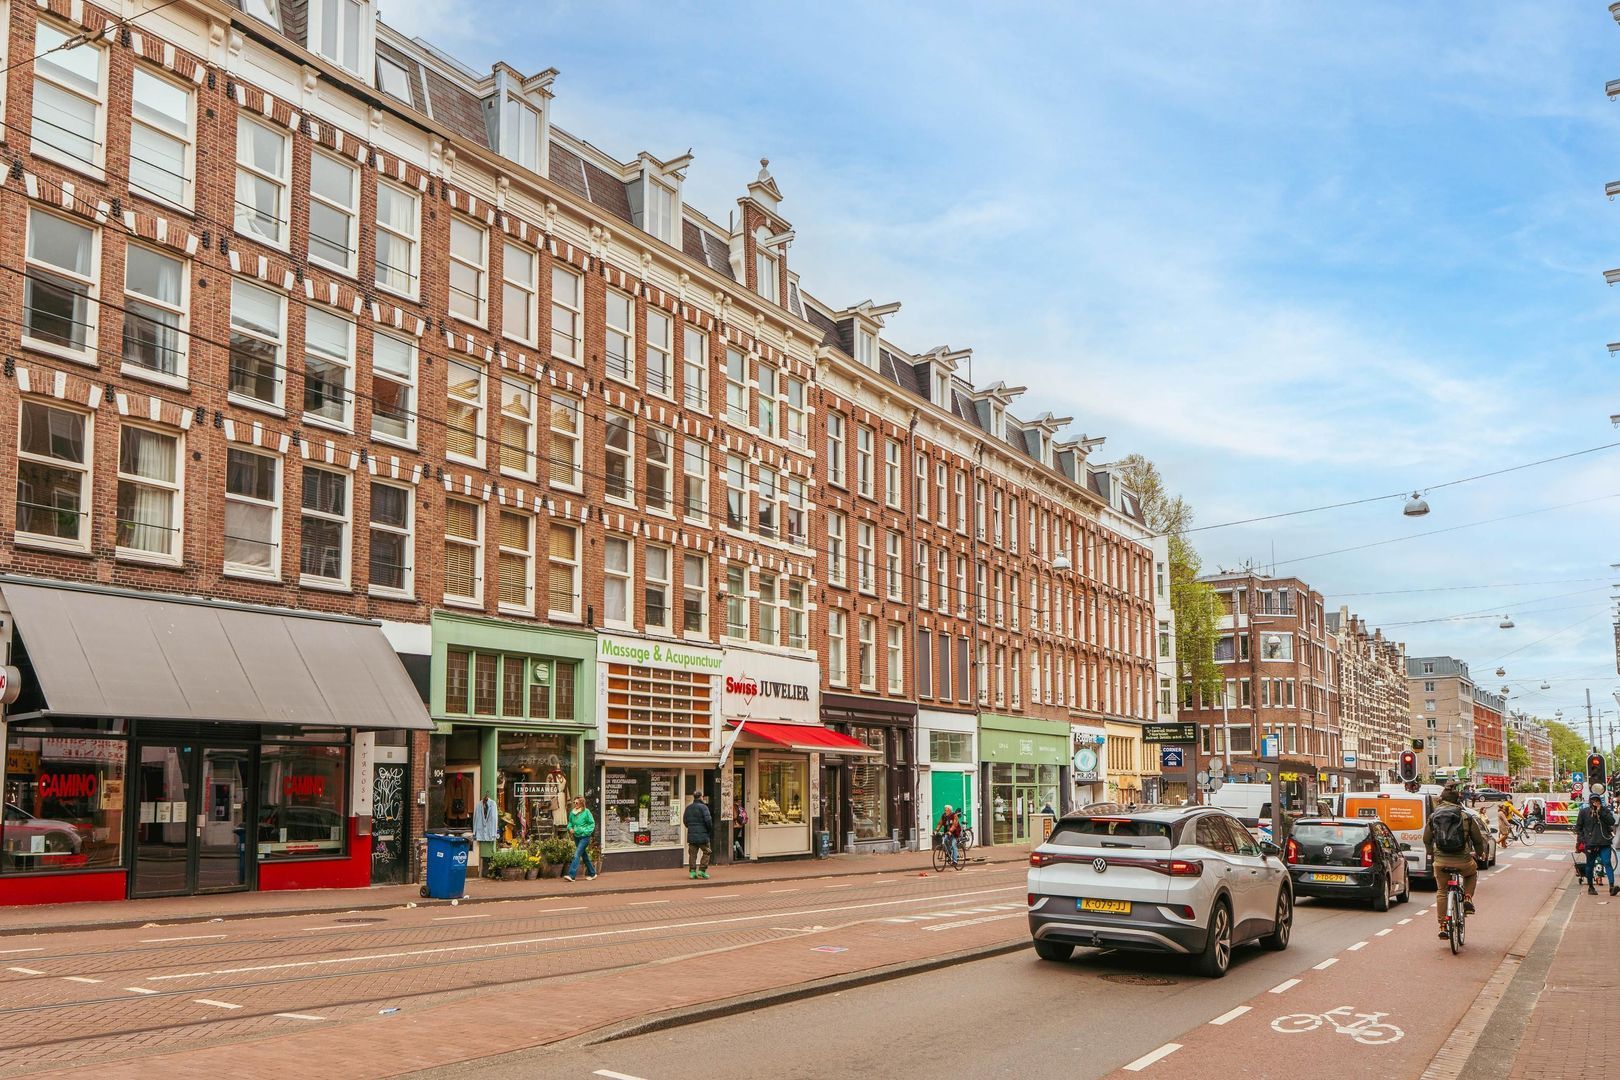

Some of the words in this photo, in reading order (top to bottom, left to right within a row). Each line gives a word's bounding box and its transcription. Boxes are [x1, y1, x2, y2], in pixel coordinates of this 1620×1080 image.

[601, 639, 650, 663] Massage
[652, 644, 662, 662] &
[665, 650, 723, 669] Acupunctuur
[759, 680, 810, 702] JUWELIER
[39, 773, 97, 799] CAMINO
[282, 775, 326, 796] CAMINO
[1085, 898, 1127, 911] K-079-JJ
